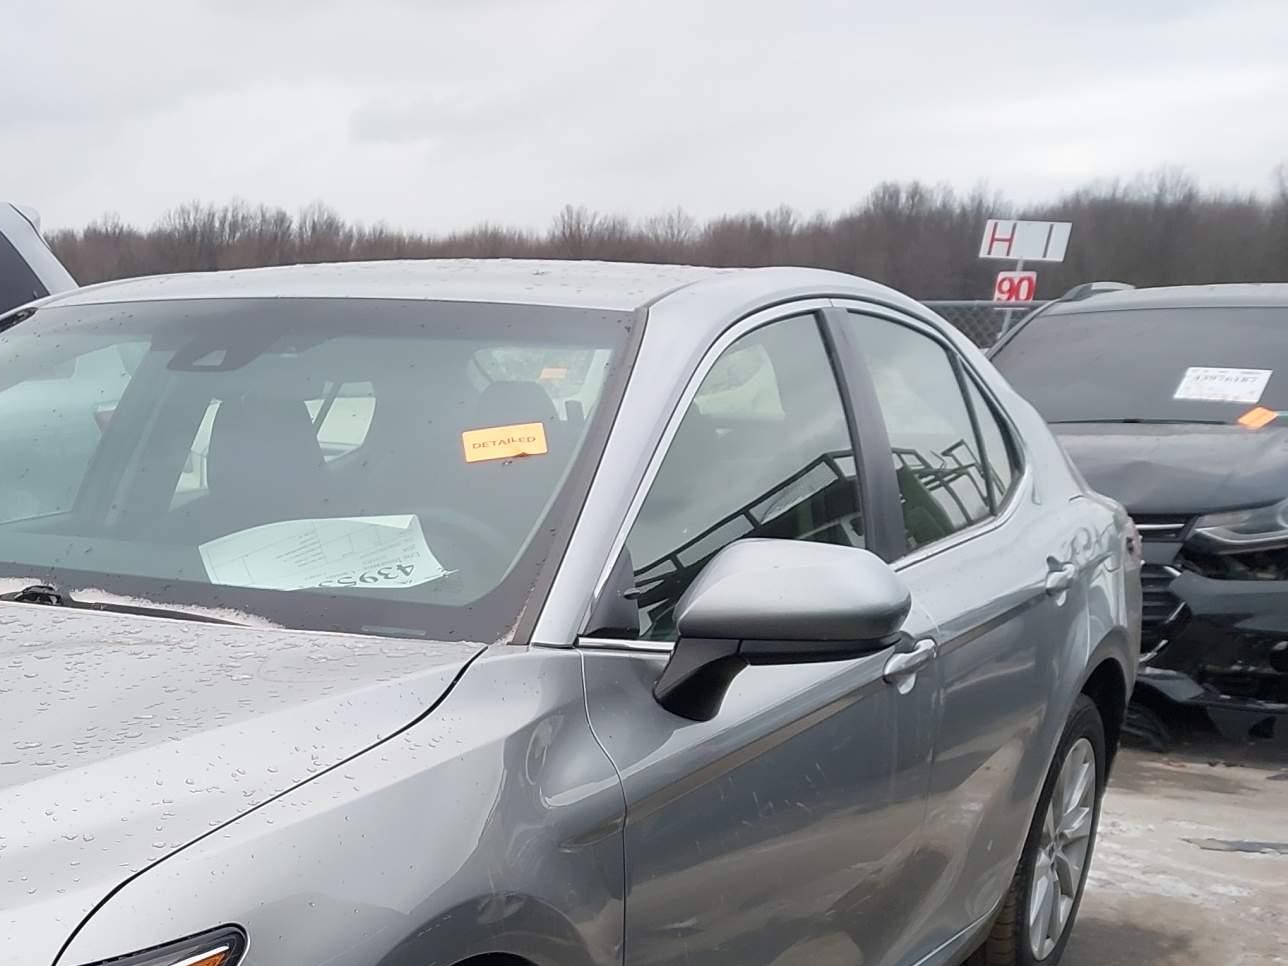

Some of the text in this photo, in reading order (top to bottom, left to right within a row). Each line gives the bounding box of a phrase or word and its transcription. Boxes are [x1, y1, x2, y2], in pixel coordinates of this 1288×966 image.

[986, 221, 1018, 256] H
[996, 276, 1036, 302] 90
[472, 436, 537, 449] DETAILED
[318, 562, 416, 588] 4395
